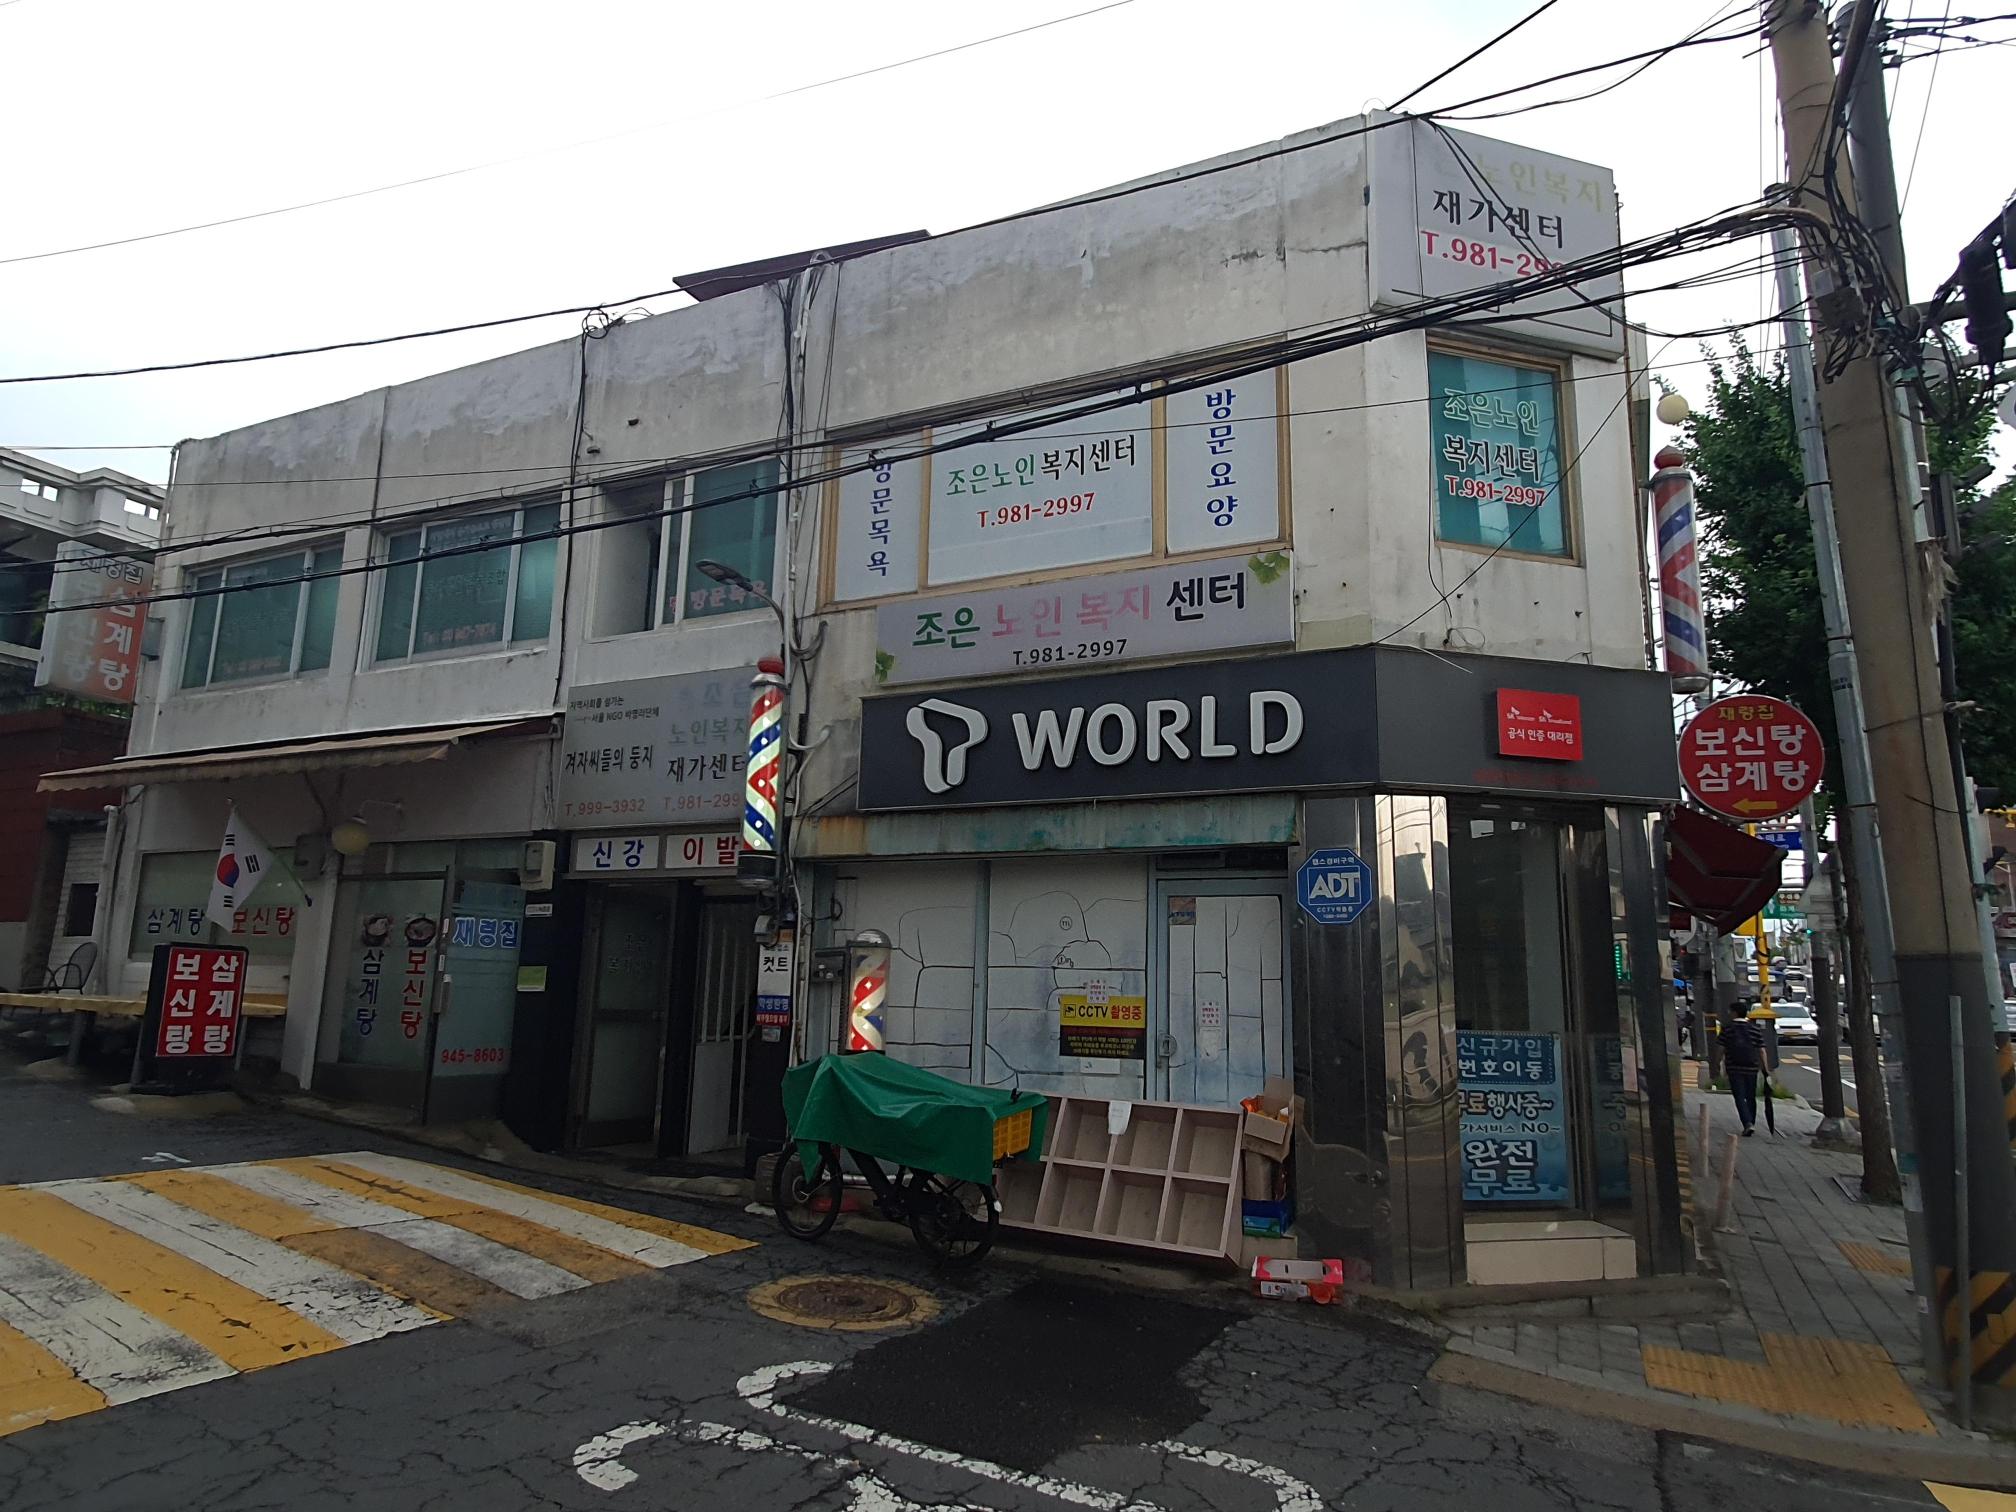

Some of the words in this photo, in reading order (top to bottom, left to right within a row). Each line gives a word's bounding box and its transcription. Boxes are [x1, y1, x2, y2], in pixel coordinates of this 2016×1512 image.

[1433, 190, 1562, 249] 재가센터
[1443, 388, 1540, 437] 조은노인
[1206, 388, 1238, 527] 방문요양
[1443, 434, 1541, 483] 복지센터
[1444, 475, 1545, 507] T.981-2997
[977, 492, 1095, 528] T.981-2997
[1013, 638, 1128, 666] T.981-2997
[1012, 690, 1304, 770] WORLD
[1508, 727, 1525, 740] 공식
[1527, 729, 1545, 742] 인증
[1547, 731, 1574, 745] 대리점
[1695, 725, 1807, 756] 보신탕
[630, 744, 653, 769] 둥지
[1697, 760, 1810, 792] 삼계탕
[1309, 871, 1360, 899] ADT
[147, 908, 205, 936] 삼계탕
[232, 907, 294, 936] 보신탕
[165, 953, 200, 1054] 보신탕
[203, 955, 239, 1054] 삼계탕
[357, 949, 384, 1036] 삼계탕
[401, 949, 427, 1040] 보신탕
[1078, 1005, 1109, 1018] CCTV
[1110, 1005, 1143, 1021] 촬영중
[441, 1047, 504, 1064] 945-8603
[1457, 1037, 1543, 1058] 신규가입
[1458, 1059, 1544, 1080] 번호이동
[1465, 1139, 1535, 1168] 완전
[1467, 1168, 1537, 1196] 무료
